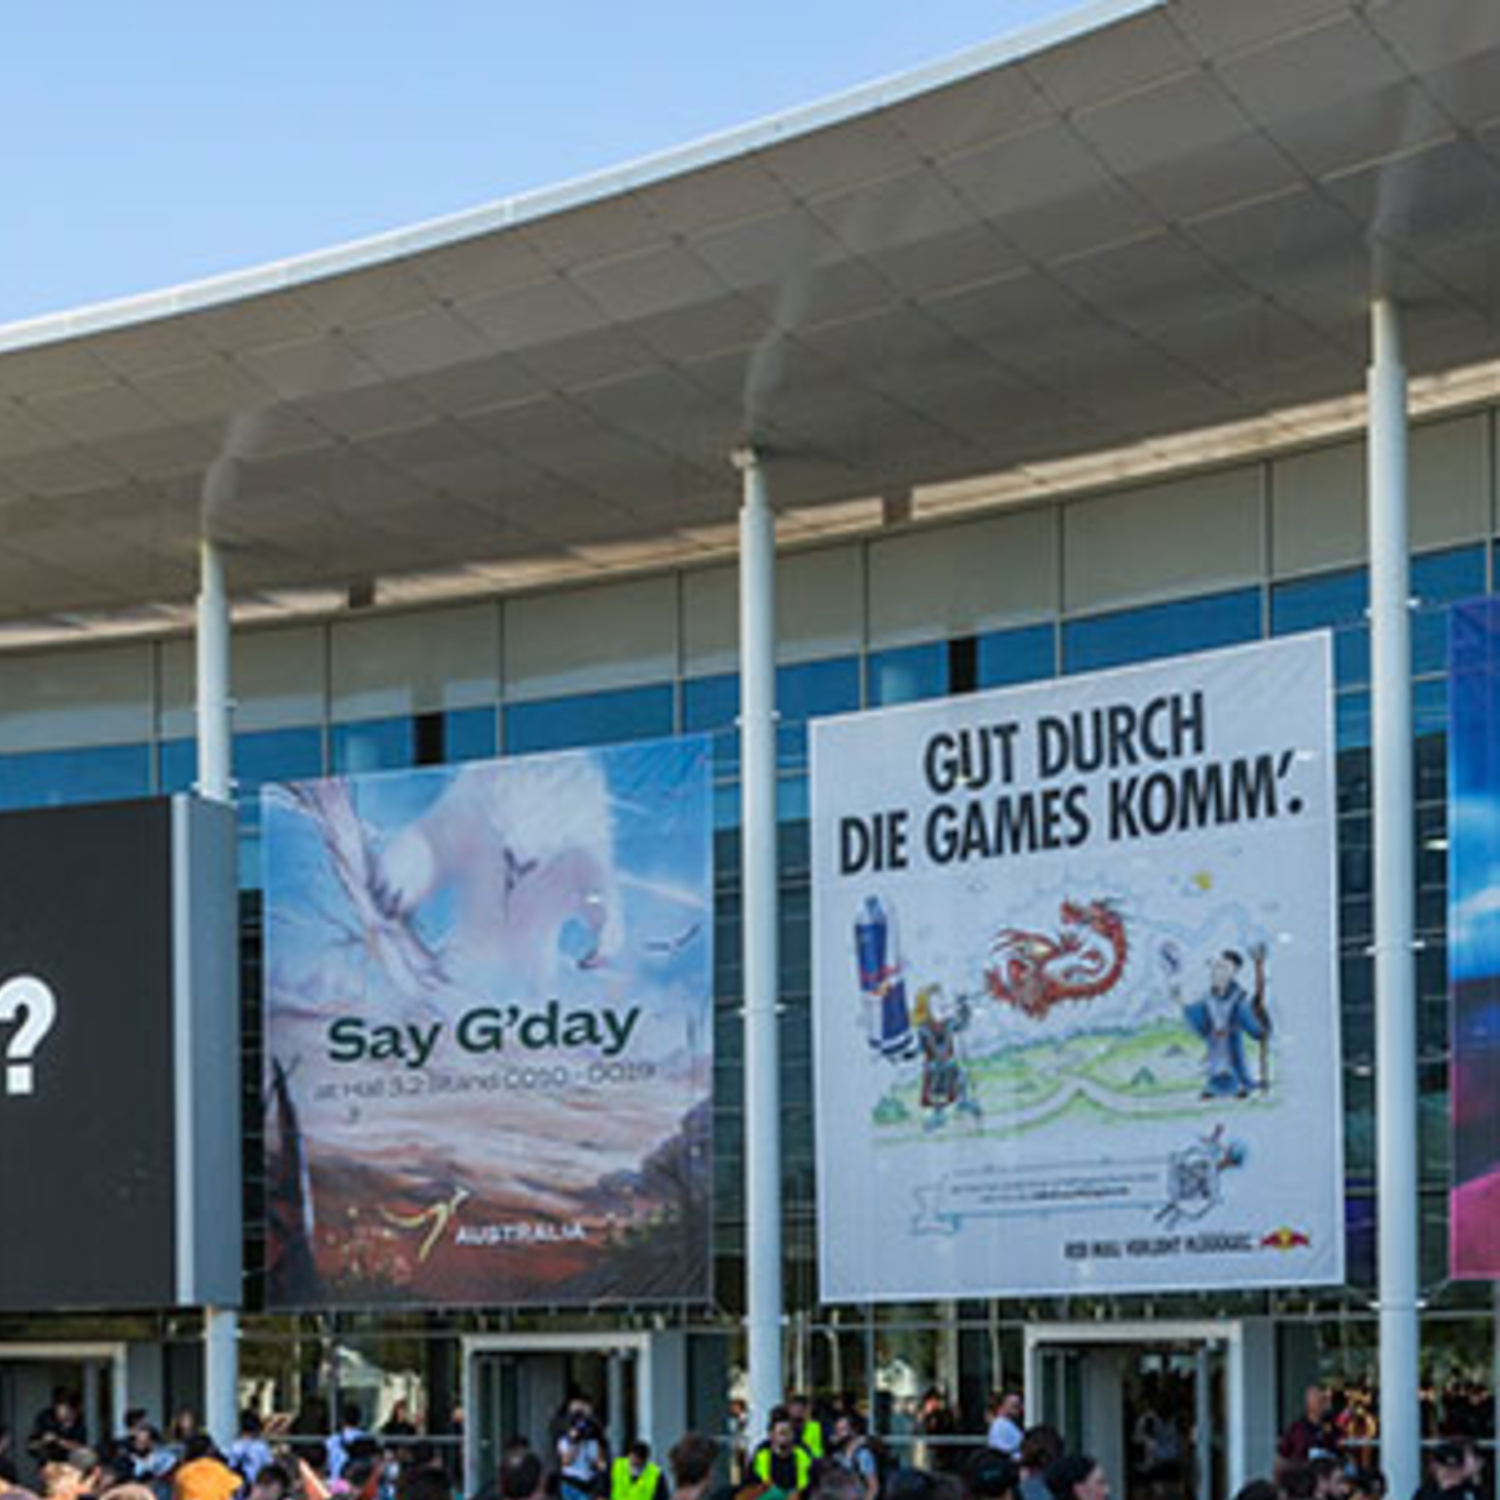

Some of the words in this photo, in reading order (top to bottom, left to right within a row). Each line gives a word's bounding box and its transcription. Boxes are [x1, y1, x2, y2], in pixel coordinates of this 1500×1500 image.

[925, 722, 1020, 795] GUT
[1038, 692, 1204, 776] DURCH
[840, 809, 908, 876] DIE
[925, 786, 1090, 866] GAMES
[327, 1016, 443, 1069] Say
[455, 1221, 587, 1246] AUSTRALIA
